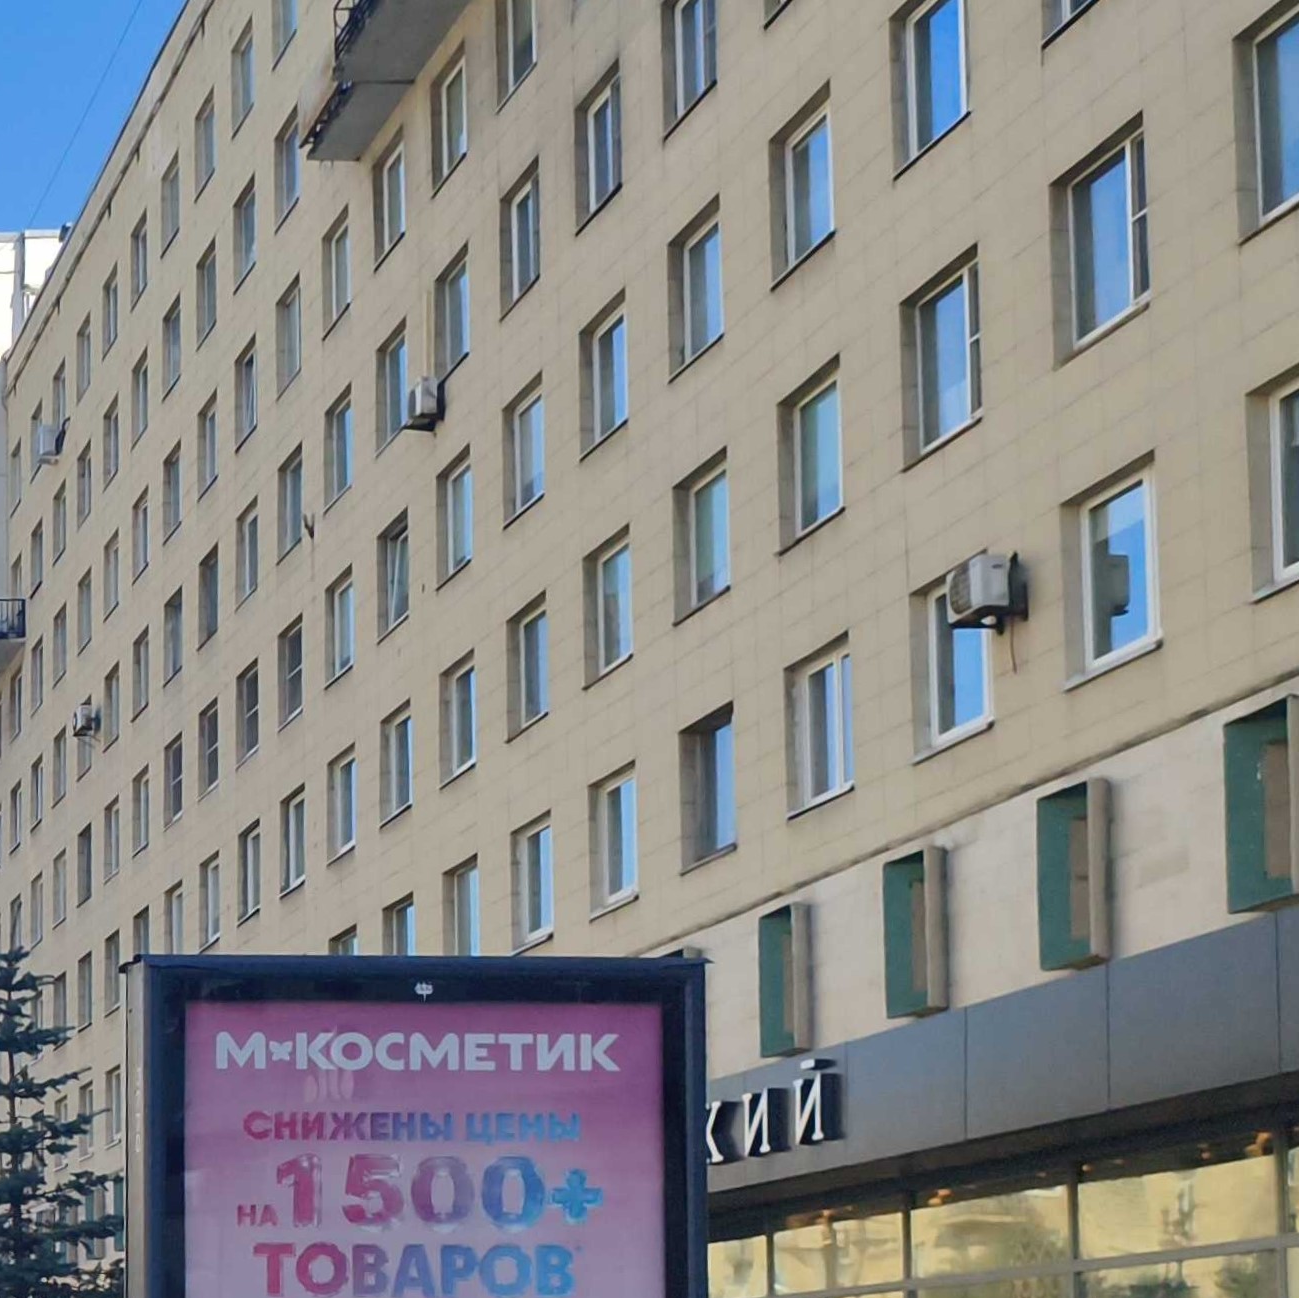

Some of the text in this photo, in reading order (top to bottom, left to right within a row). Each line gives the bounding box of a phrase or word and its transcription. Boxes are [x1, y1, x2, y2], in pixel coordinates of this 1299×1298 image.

[242, 1110, 582, 1145] СНИЖЕНЫ ЦЕНЫ
[236, 1203, 279, 1228] НА
